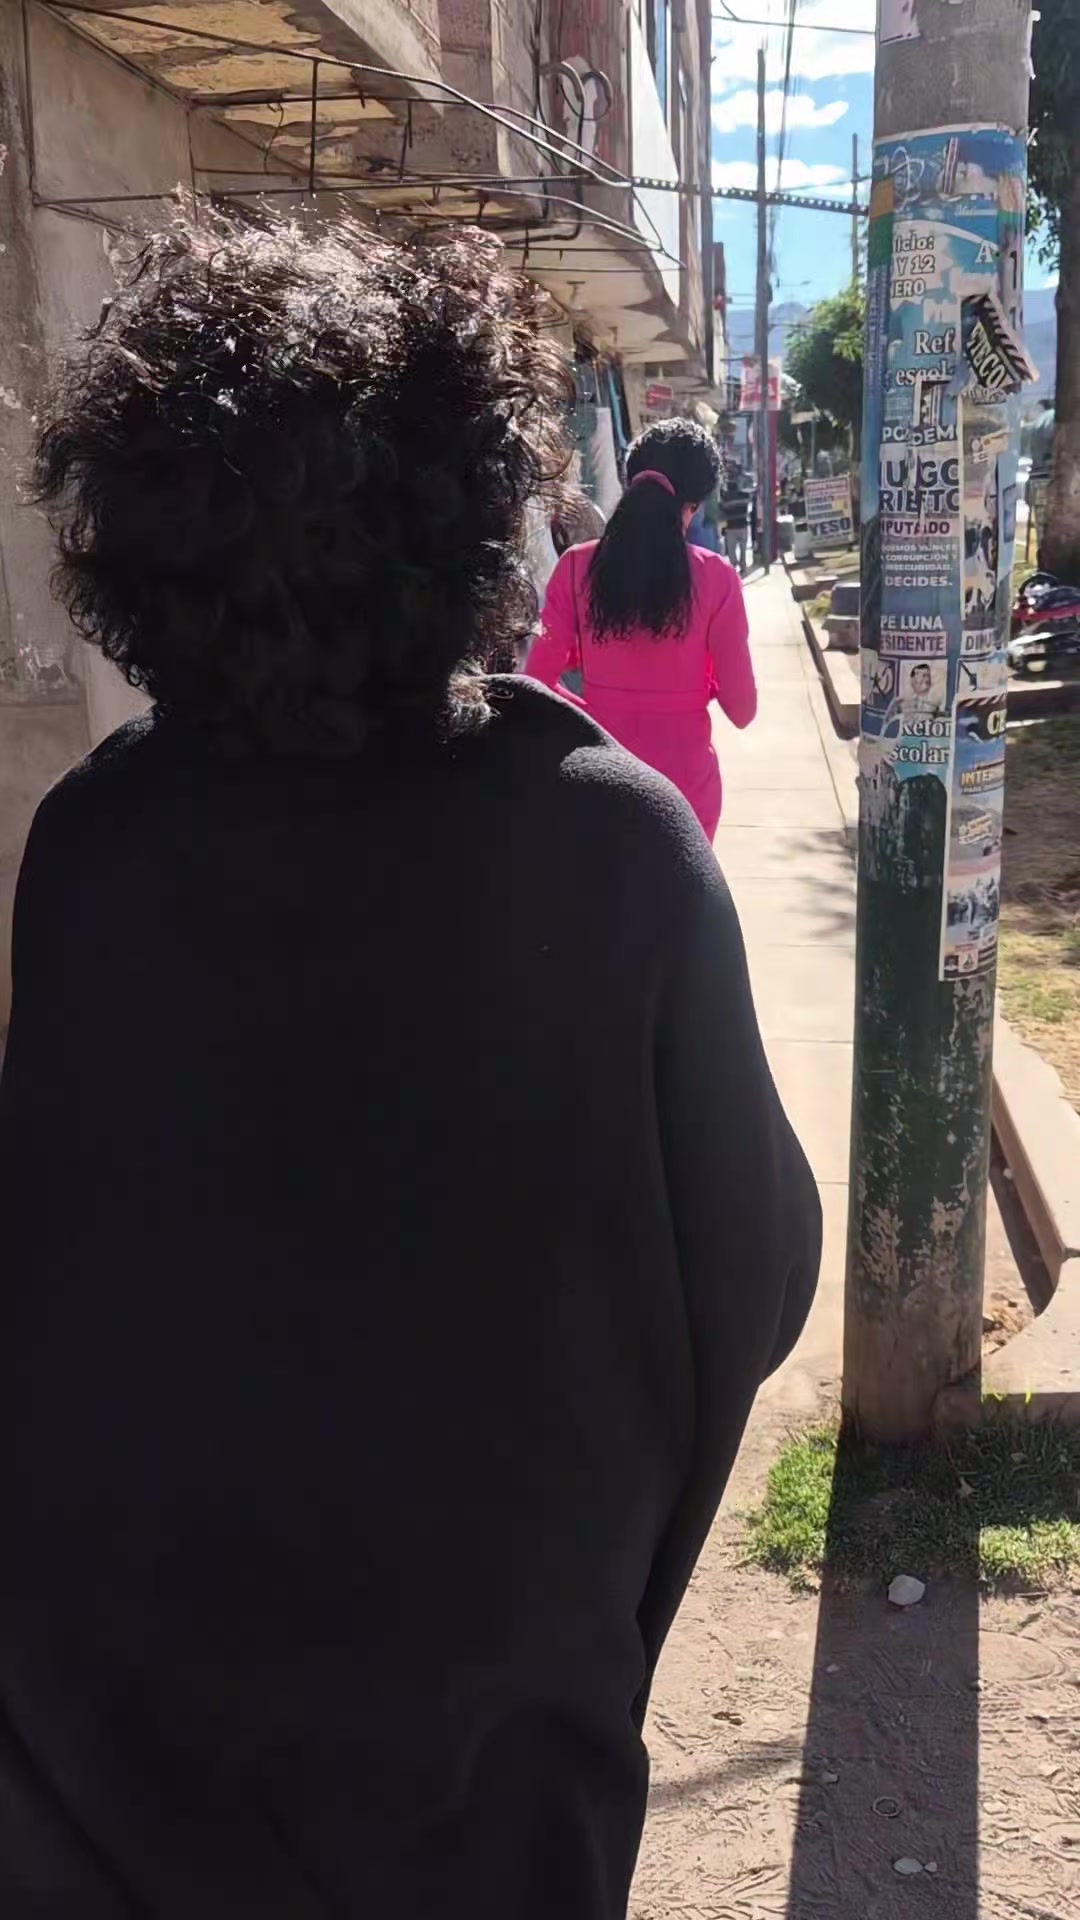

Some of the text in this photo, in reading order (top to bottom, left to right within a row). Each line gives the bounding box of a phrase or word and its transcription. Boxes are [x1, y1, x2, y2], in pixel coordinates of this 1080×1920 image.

[911, 254, 936, 275] 12
[884, 576, 953, 587] DECIDES.
[900, 615, 943, 629] LUNA
